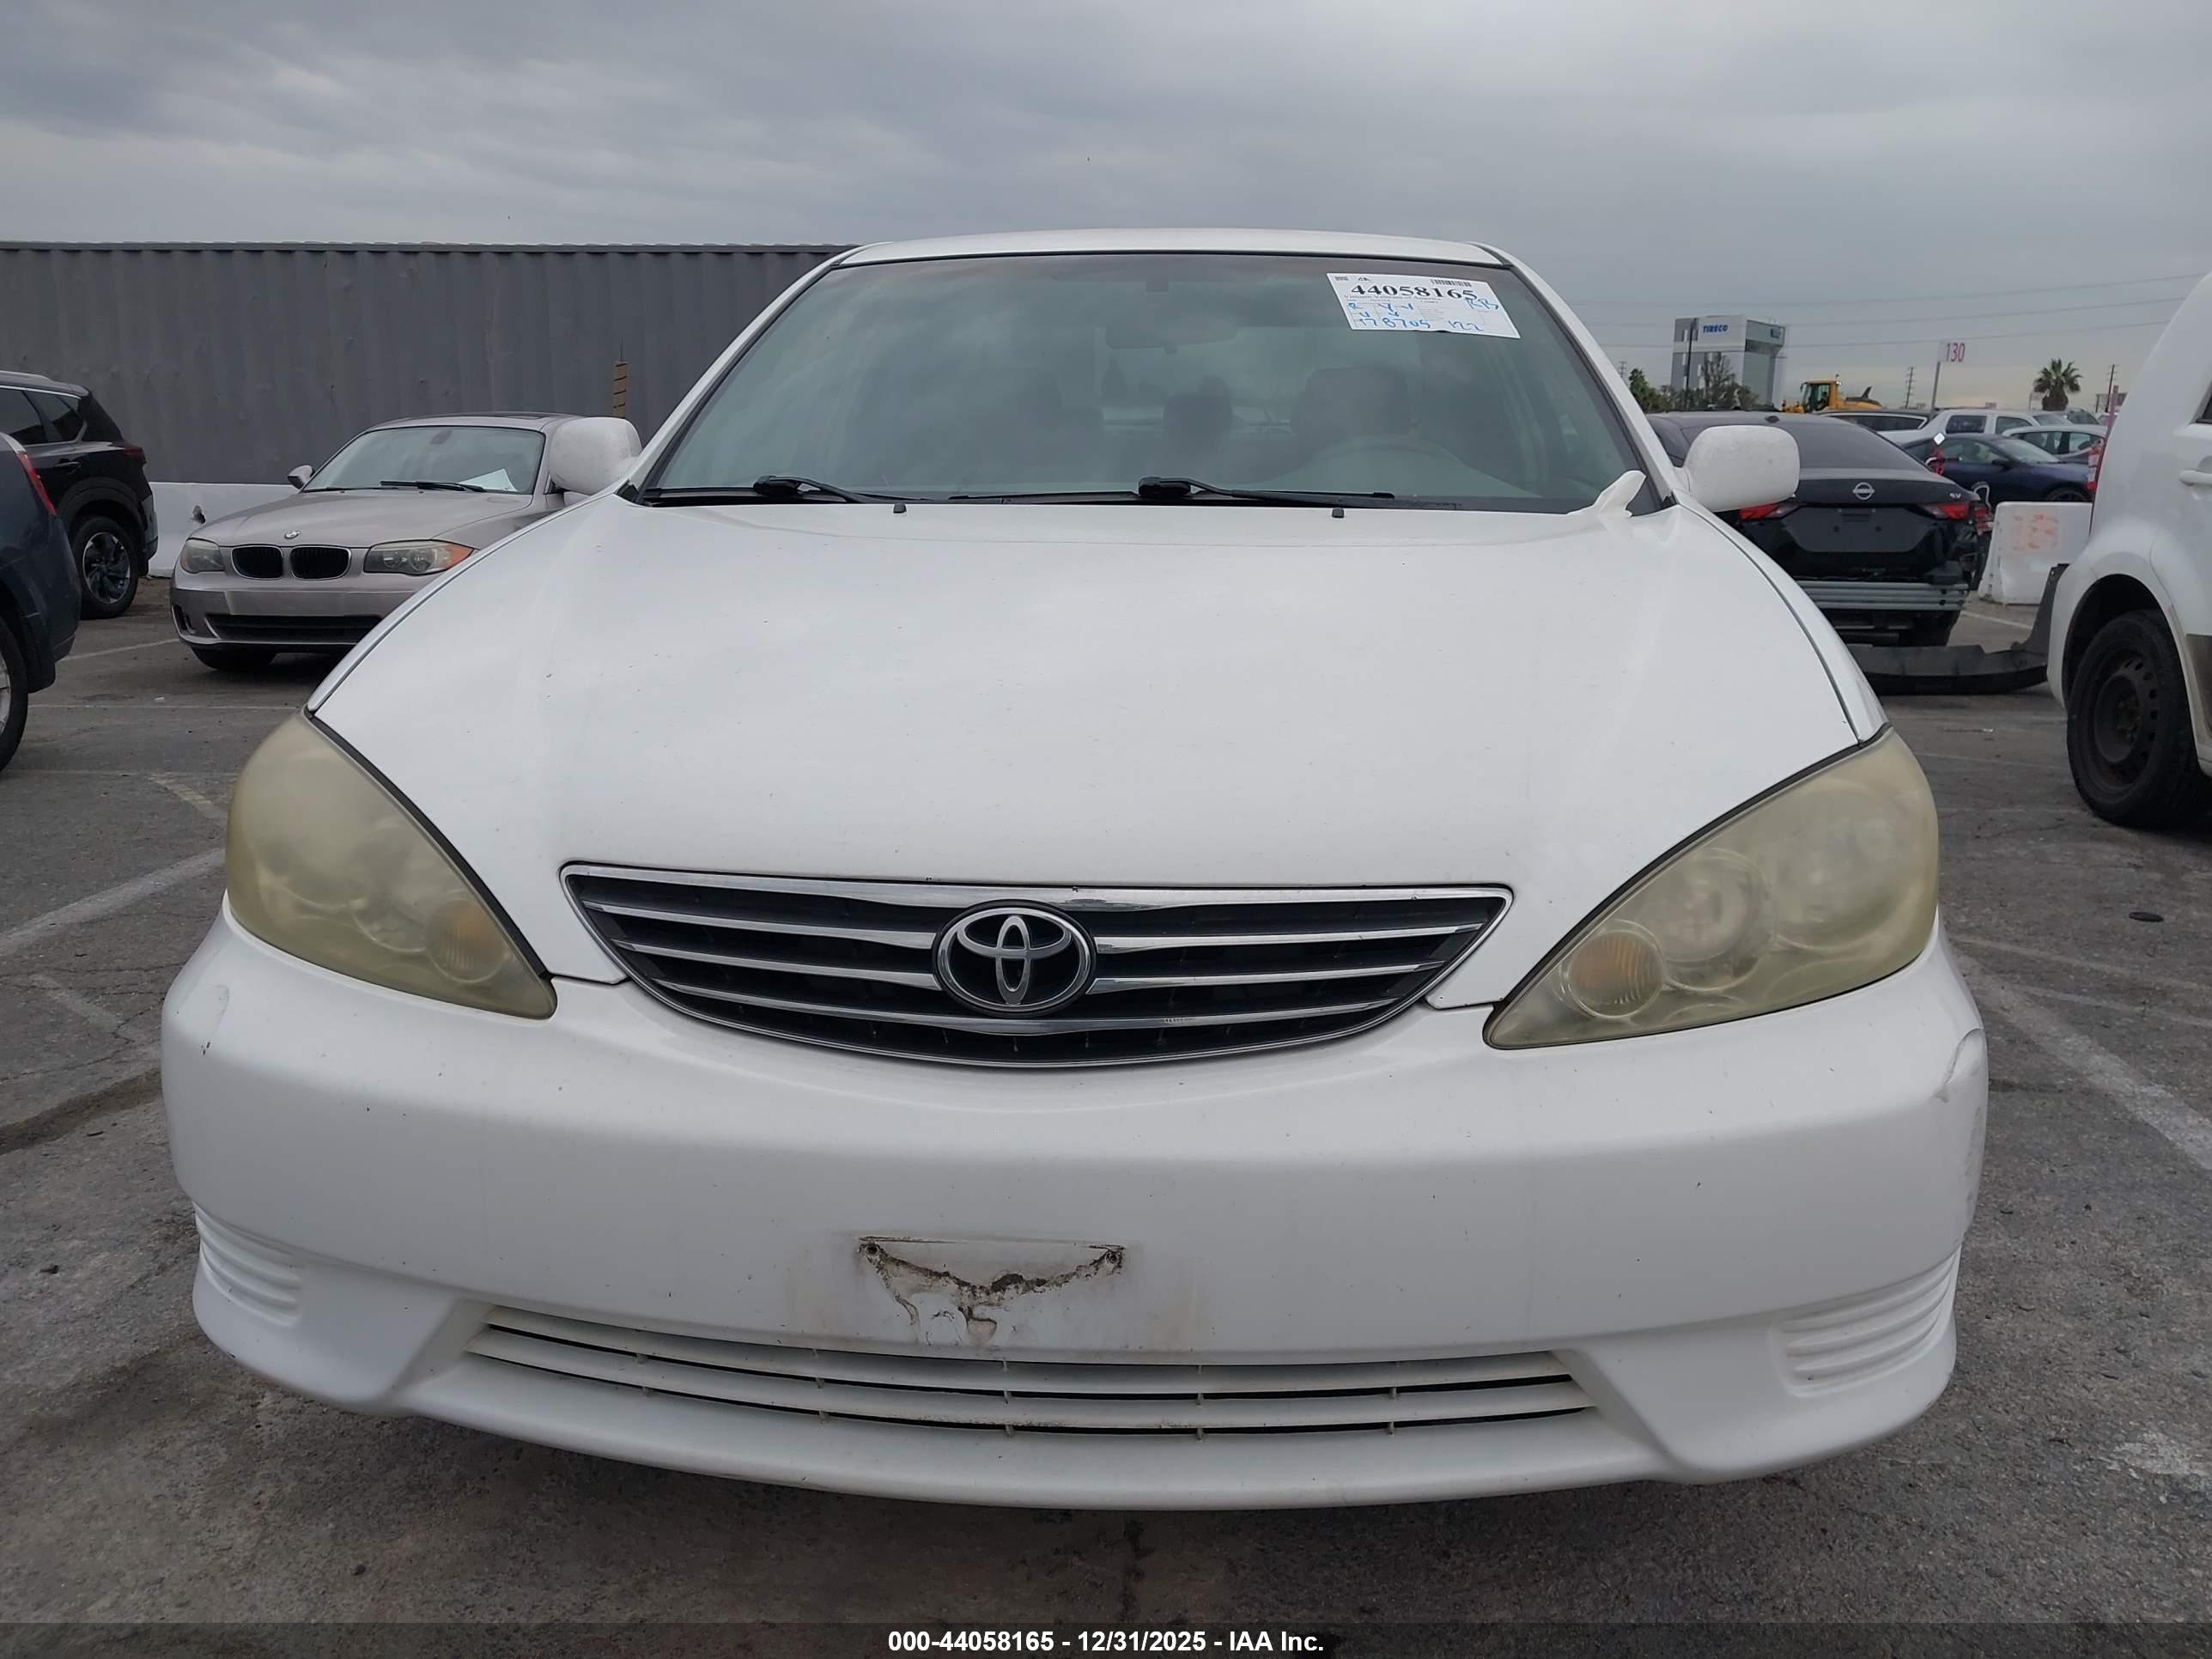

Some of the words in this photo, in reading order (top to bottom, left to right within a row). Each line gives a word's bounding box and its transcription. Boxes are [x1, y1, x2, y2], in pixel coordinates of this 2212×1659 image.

[1351, 284, 1478, 300] 44058165
[1703, 325, 1729, 333] TIRECO
[1946, 343, 1966, 362] 130
